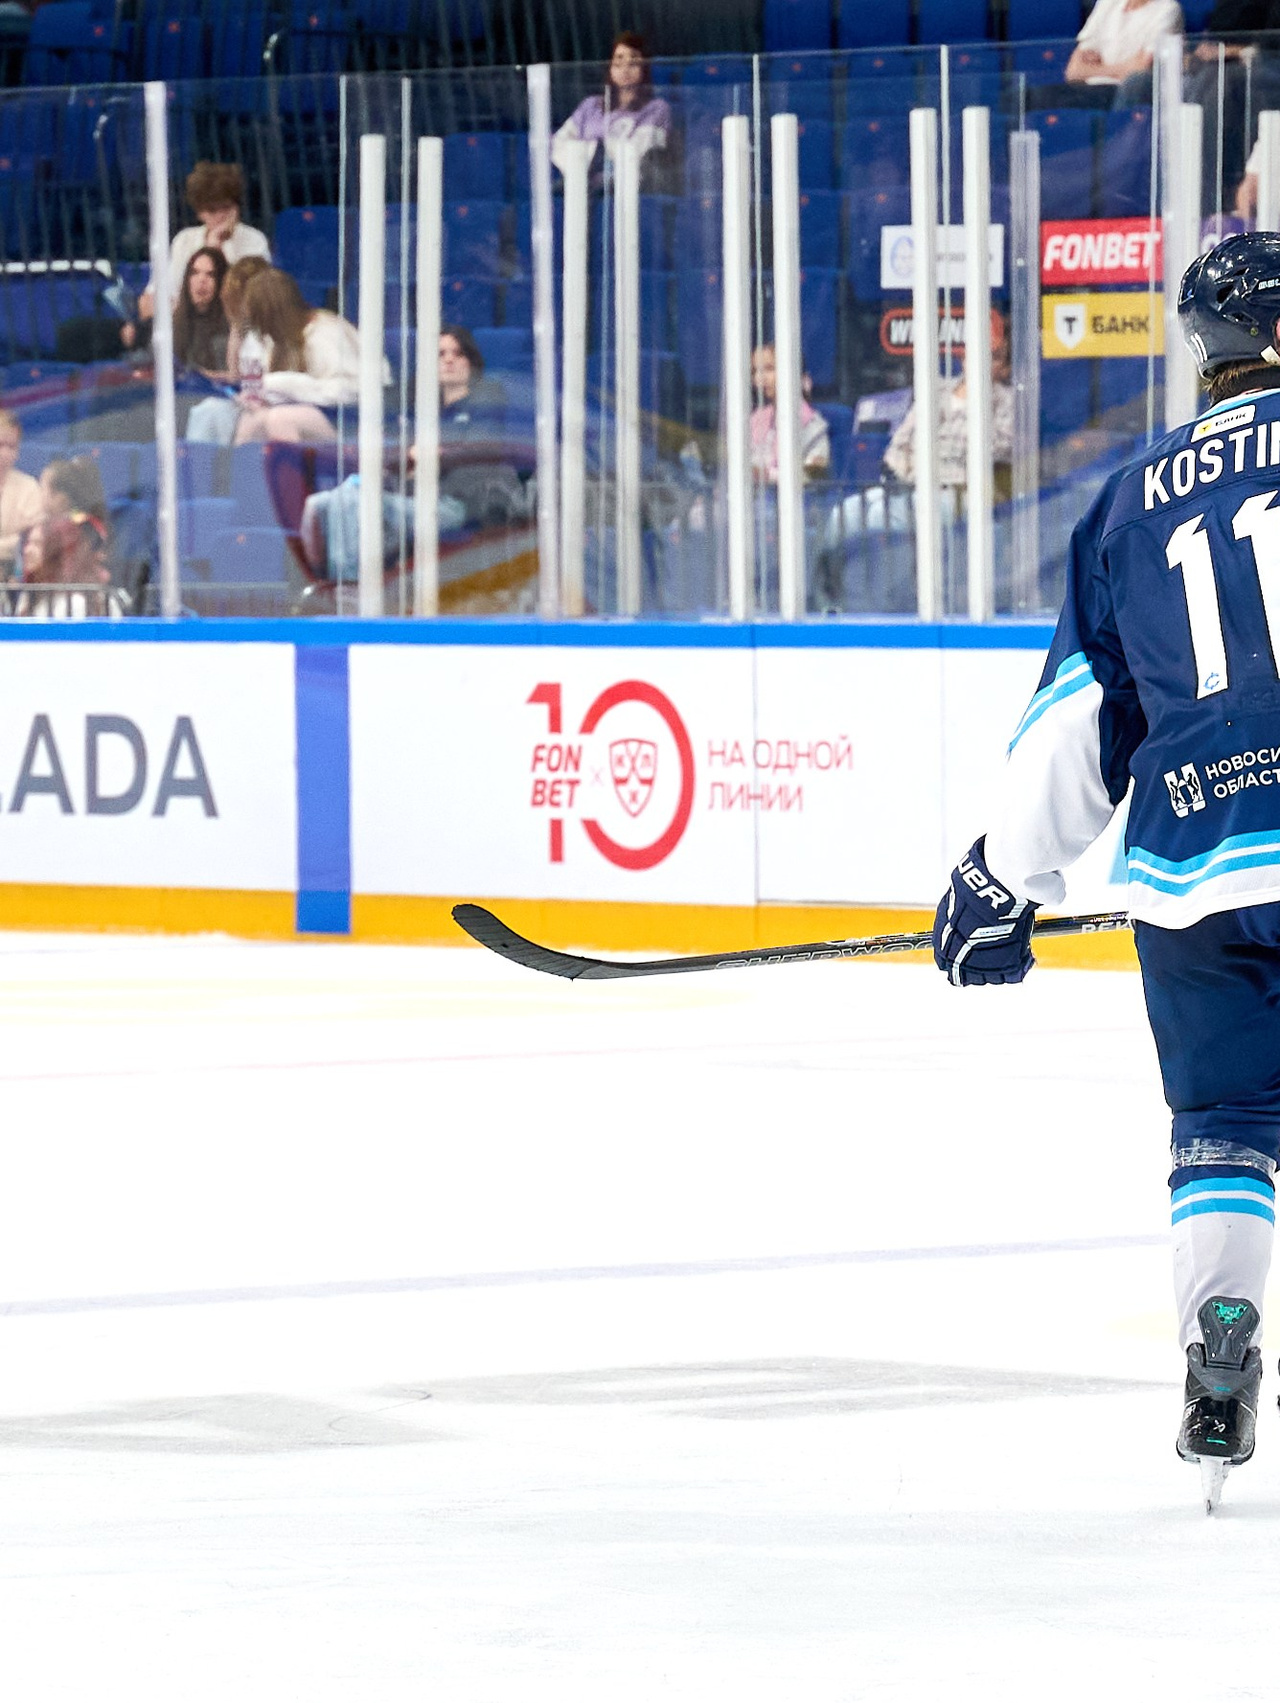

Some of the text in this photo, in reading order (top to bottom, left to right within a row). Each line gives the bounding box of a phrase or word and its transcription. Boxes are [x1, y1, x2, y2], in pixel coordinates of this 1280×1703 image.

[1043, 231, 1161, 271] FONBET
[1092, 313, 1151, 335] БАНК
[0, 713, 219, 819] ADA
[531, 744, 582, 773] FON
[708, 734, 854, 775] НА ОДНОЙ
[531, 778, 581, 808] BET
[708, 782, 804, 813] ЛИНИИ
